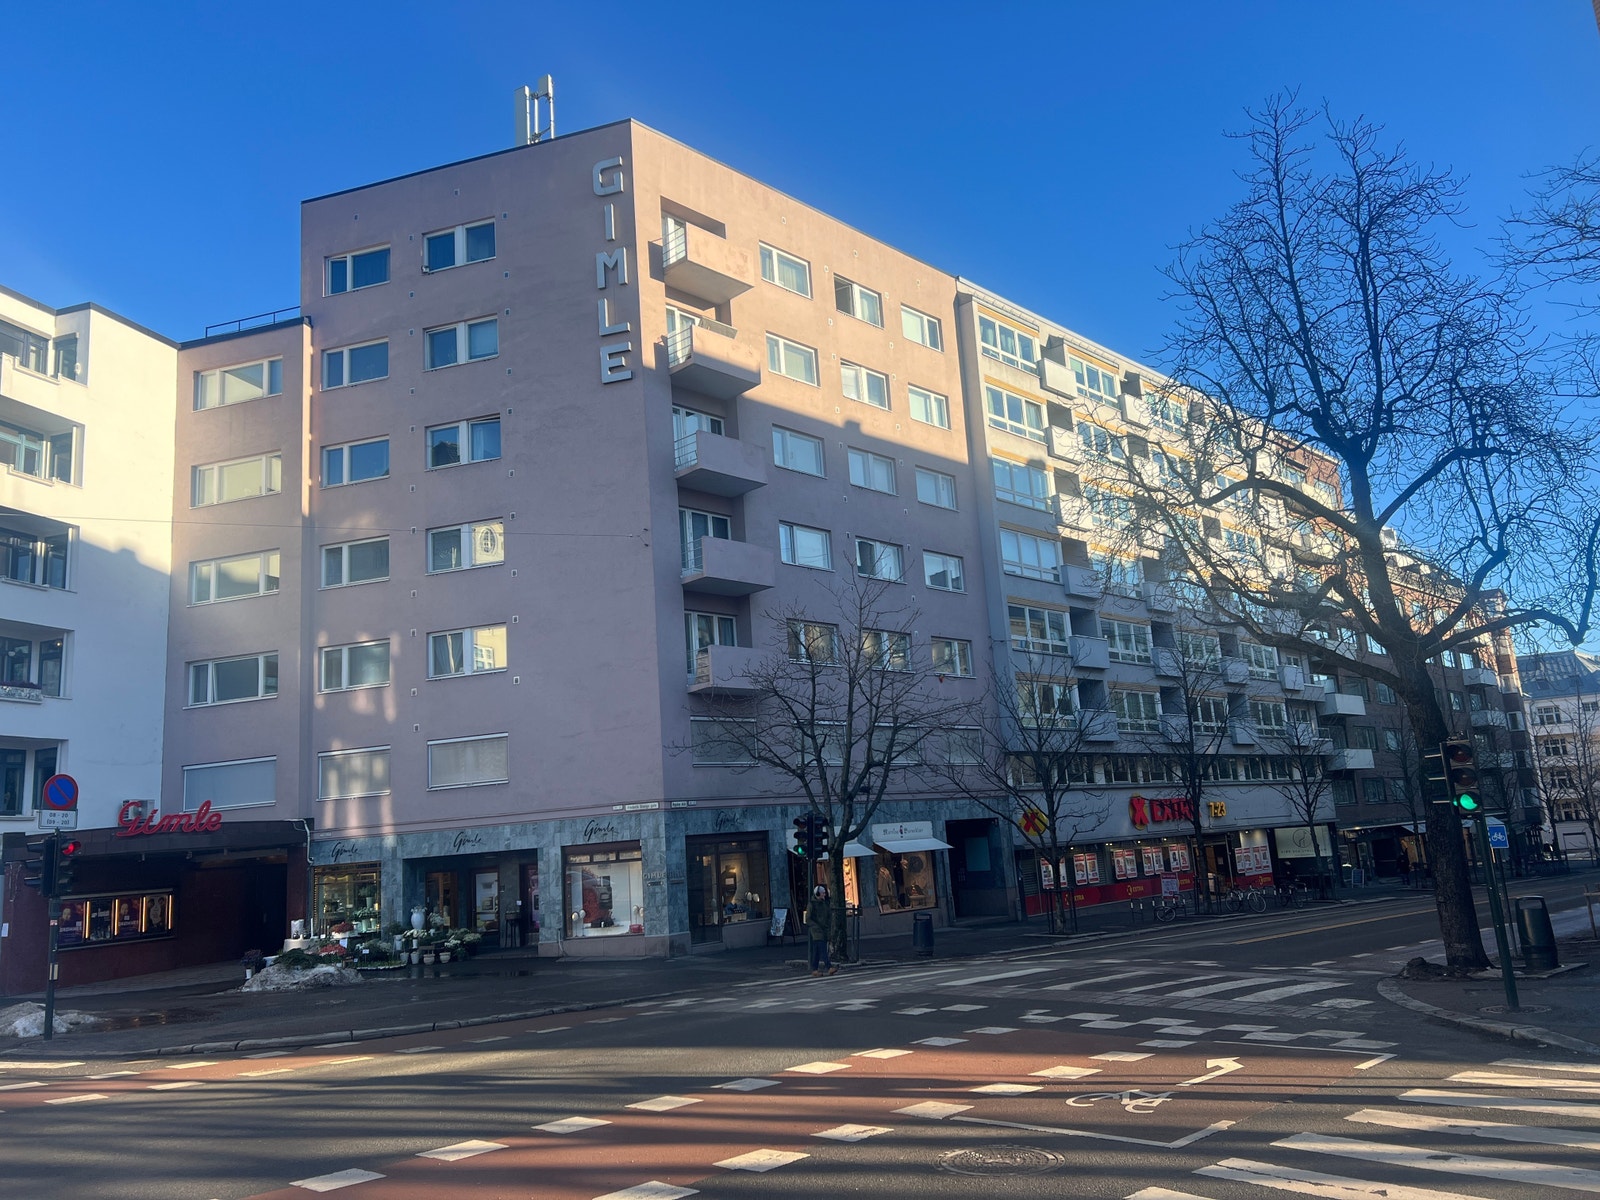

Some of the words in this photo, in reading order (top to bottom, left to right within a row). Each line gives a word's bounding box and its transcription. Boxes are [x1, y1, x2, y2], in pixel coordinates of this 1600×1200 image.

[593, 156, 632, 384] GIMLE
[116, 800, 222, 837] Gimle
[453, 831, 487, 848] Gimle
[584, 819, 620, 841] Gimle
[330, 842, 361, 862] Gimle
